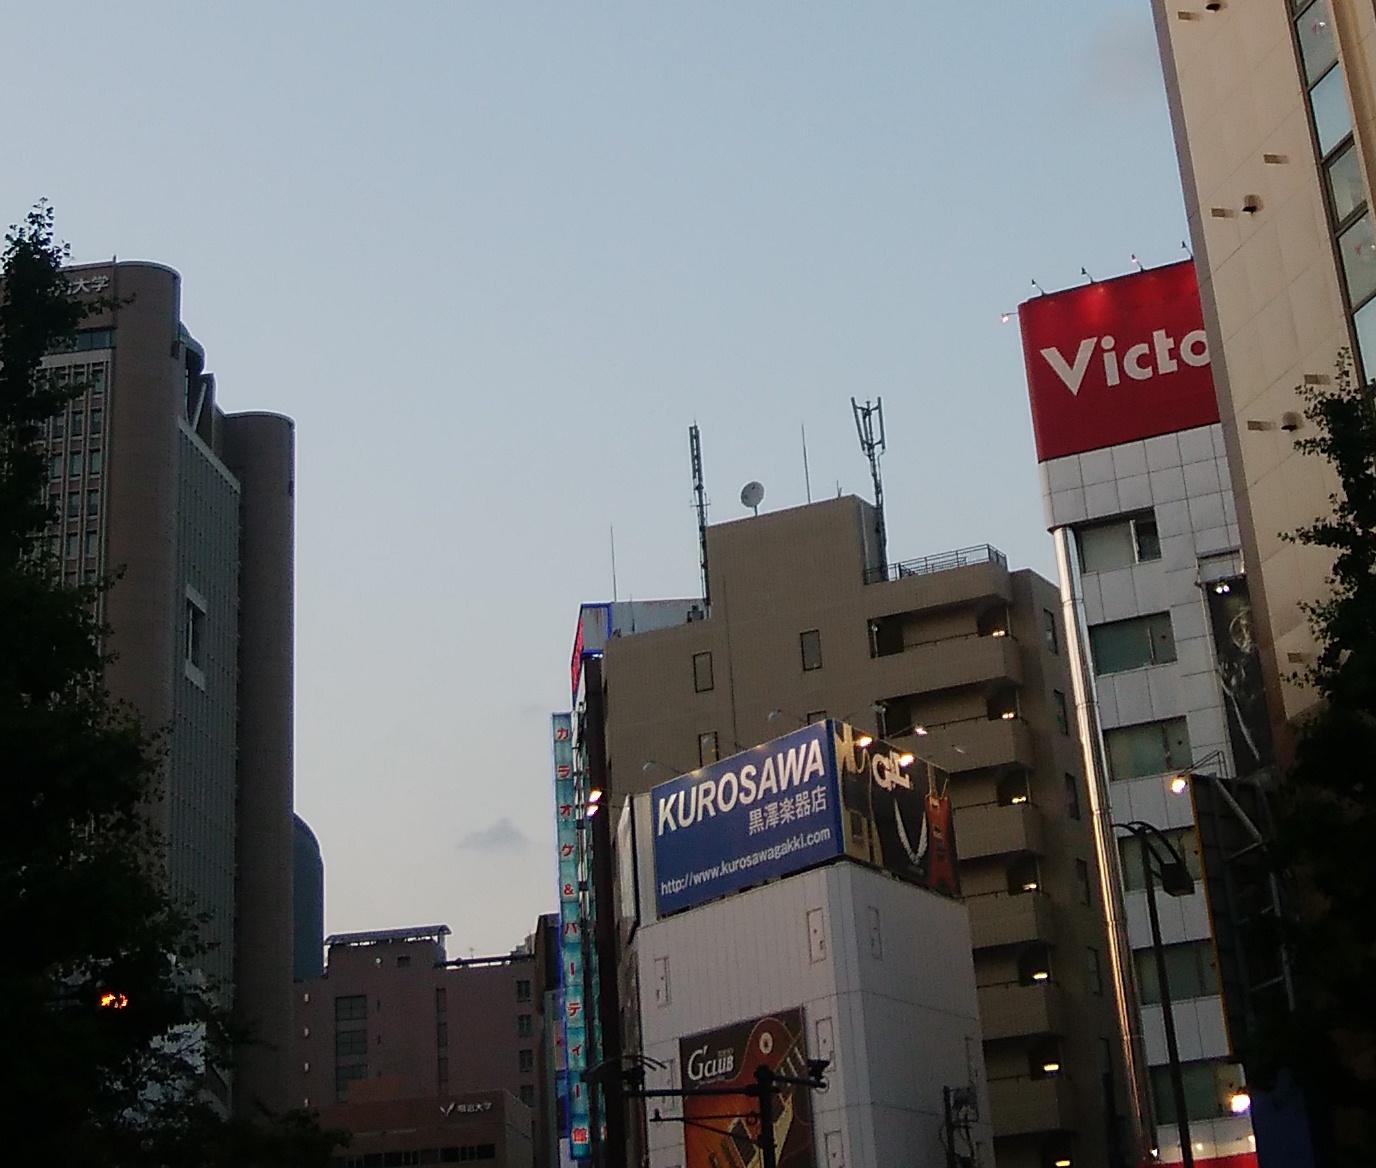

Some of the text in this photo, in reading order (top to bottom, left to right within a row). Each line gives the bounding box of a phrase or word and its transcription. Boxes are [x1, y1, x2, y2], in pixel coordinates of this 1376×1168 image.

[658, 739, 825, 836] KUROSAWA
[748, 786, 827, 836] 黒澤楽器店
[660, 826, 832, 896] http://www.kurosawagakki.com
